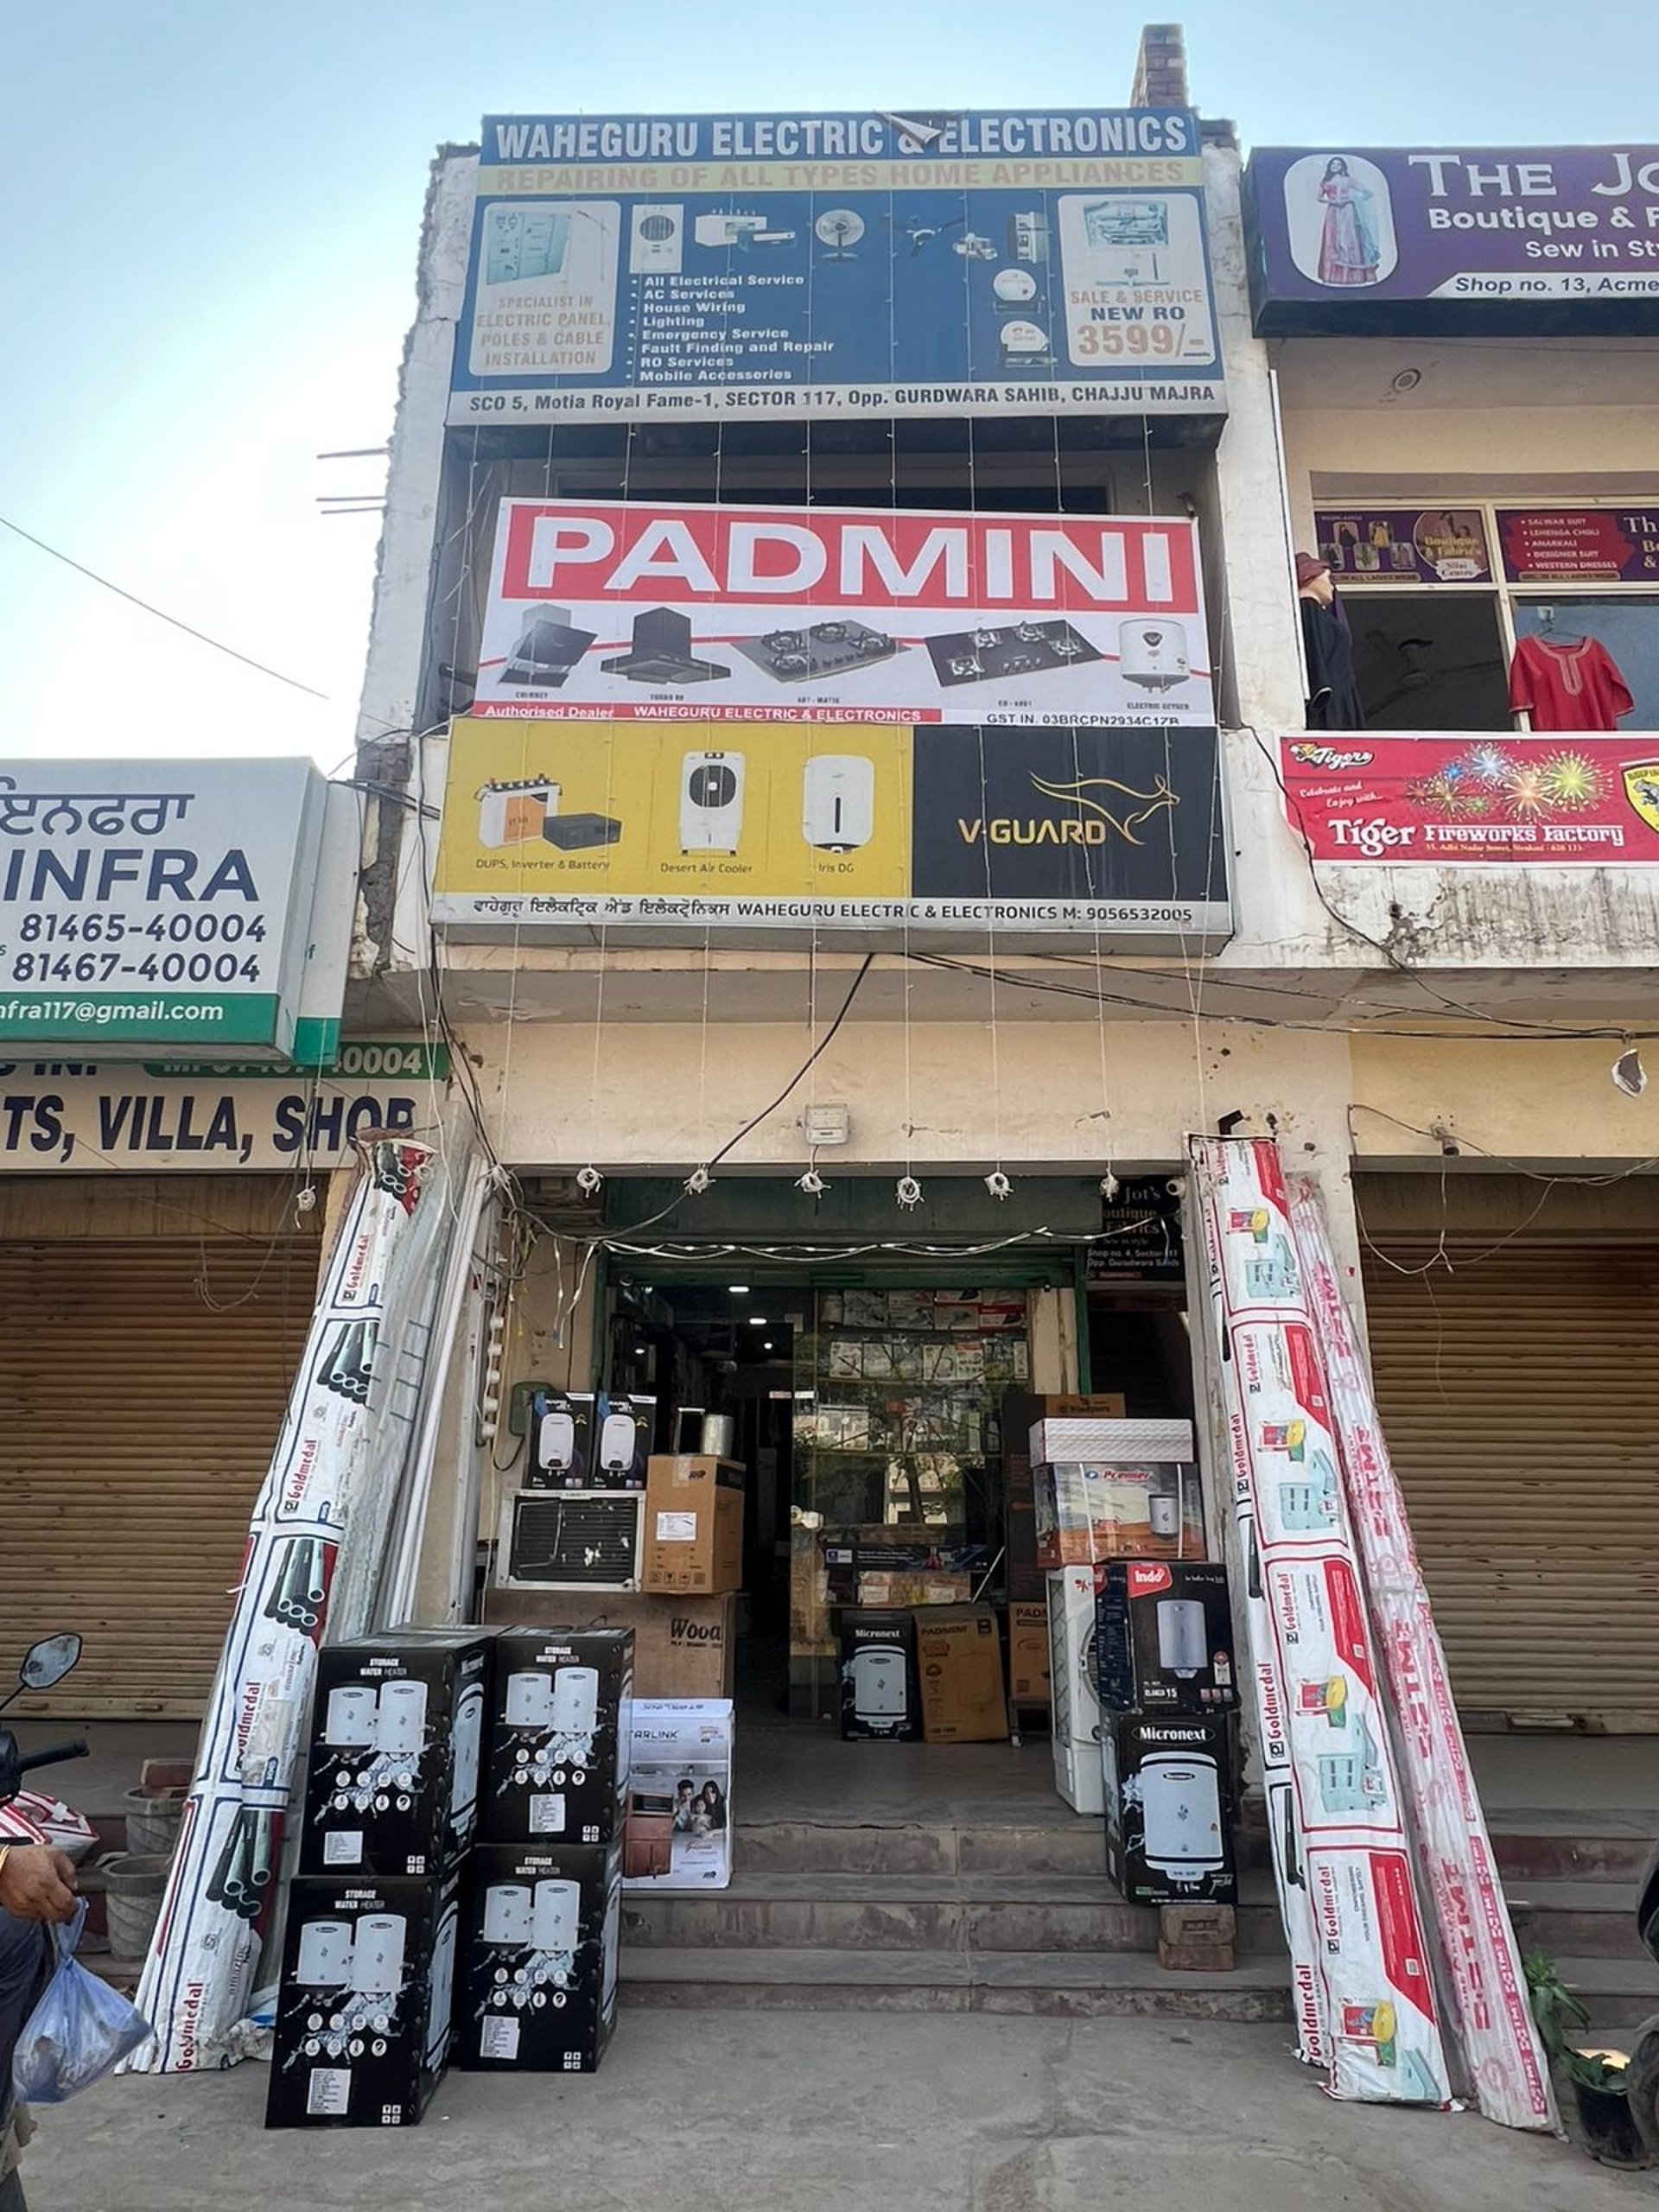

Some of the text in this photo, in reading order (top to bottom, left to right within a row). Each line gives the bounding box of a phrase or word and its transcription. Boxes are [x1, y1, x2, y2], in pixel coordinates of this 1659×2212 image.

[496, 116, 1187, 159] WAHEGURU ELECTRIC & ELECTRONICS
[497, 162, 1185, 191] REPAIRING OF ALL TYPES HOME APPLIANCES
[1408, 153, 1558, 198] THE
[1428, 206, 1636, 236] Boutique &
[1525, 240, 1585, 258] Sew
[1592, 239, 1619, 257] in
[645, 275, 804, 287] All Electrical Service
[1455, 277, 1659, 295] Shop no. 13, Acme
[498, 296, 594, 309] SPECIALIST IN
[644, 289, 735, 300] AC Services
[1071, 289, 1203, 304] SALE & SERVICE
[643, 302, 747, 315] House Wiring
[1090, 306, 1186, 321] NEW RO
[476, 312, 612, 328] ELECTRIC PANEL,
[643, 315, 705, 328] Lighting
[480, 332, 604, 347] POLES & CABLE
[642, 327, 790, 341] Emergency Service
[1077, 323, 1205, 357] 3599/-
[642, 341, 835, 356] Fault Finding and Repair
[486, 352, 596, 366] INSTALLATION
[641, 356, 734, 367] RO Services
[640, 369, 792, 381] Mobile Accessories
[469, 385, 1215, 412] SCO 5, Motia Royal Fame-1, SECTOR 117, Opp. GURDWARA SAHIB, CHAJJU MAJRA
[528, 516, 1173, 602] PADMINI
[486, 705, 921, 721] Authorised Dealer WAHEGURU ELECTRIC & ELECTRONICS
[987, 713, 1015, 725] GST
[1344, 780, 1363, 792] and
[1328, 818, 1625, 857] Tiger Fireworks Factory
[476, 858, 611, 873] DUPS, Inverter & Battery
[660, 862, 753, 874] Desert Air Cooler
[818, 863, 855, 874] Iris DG
[3, 849, 260, 902] INFRA
[738, 903, 1192, 922] WAHEGURU ELECTRIC & ELECTRONICS M: 9056532005
[20, 913, 267, 944] 81465-40004
[12, 952, 261, 982] 81467-40004
[3, 1094, 76, 1163] TS,
[99, 1095, 253, 1164] VILLA,
[1124, 1185, 1161, 1204] Jot's
[347, 1235, 371, 1289] Goldmedal
[1241, 1333, 1262, 1384] Goldmedal
[1230, 1413, 1249, 1478] Goldmedal
[288, 1438, 318, 1500] Goldmedal
[1275, 1572, 1297, 1631] Goldmedal
[855, 1629, 900, 1639] Micronext
[1257, 1662, 1281, 1740] Goldmedal
[1140, 1726, 1207, 1741] Micronext
[345, 1889, 378, 1900] STORAGE
[1318, 1865, 1338, 1939] Goldmedal
[1295, 1964, 1323, 2059] Goldmedal
